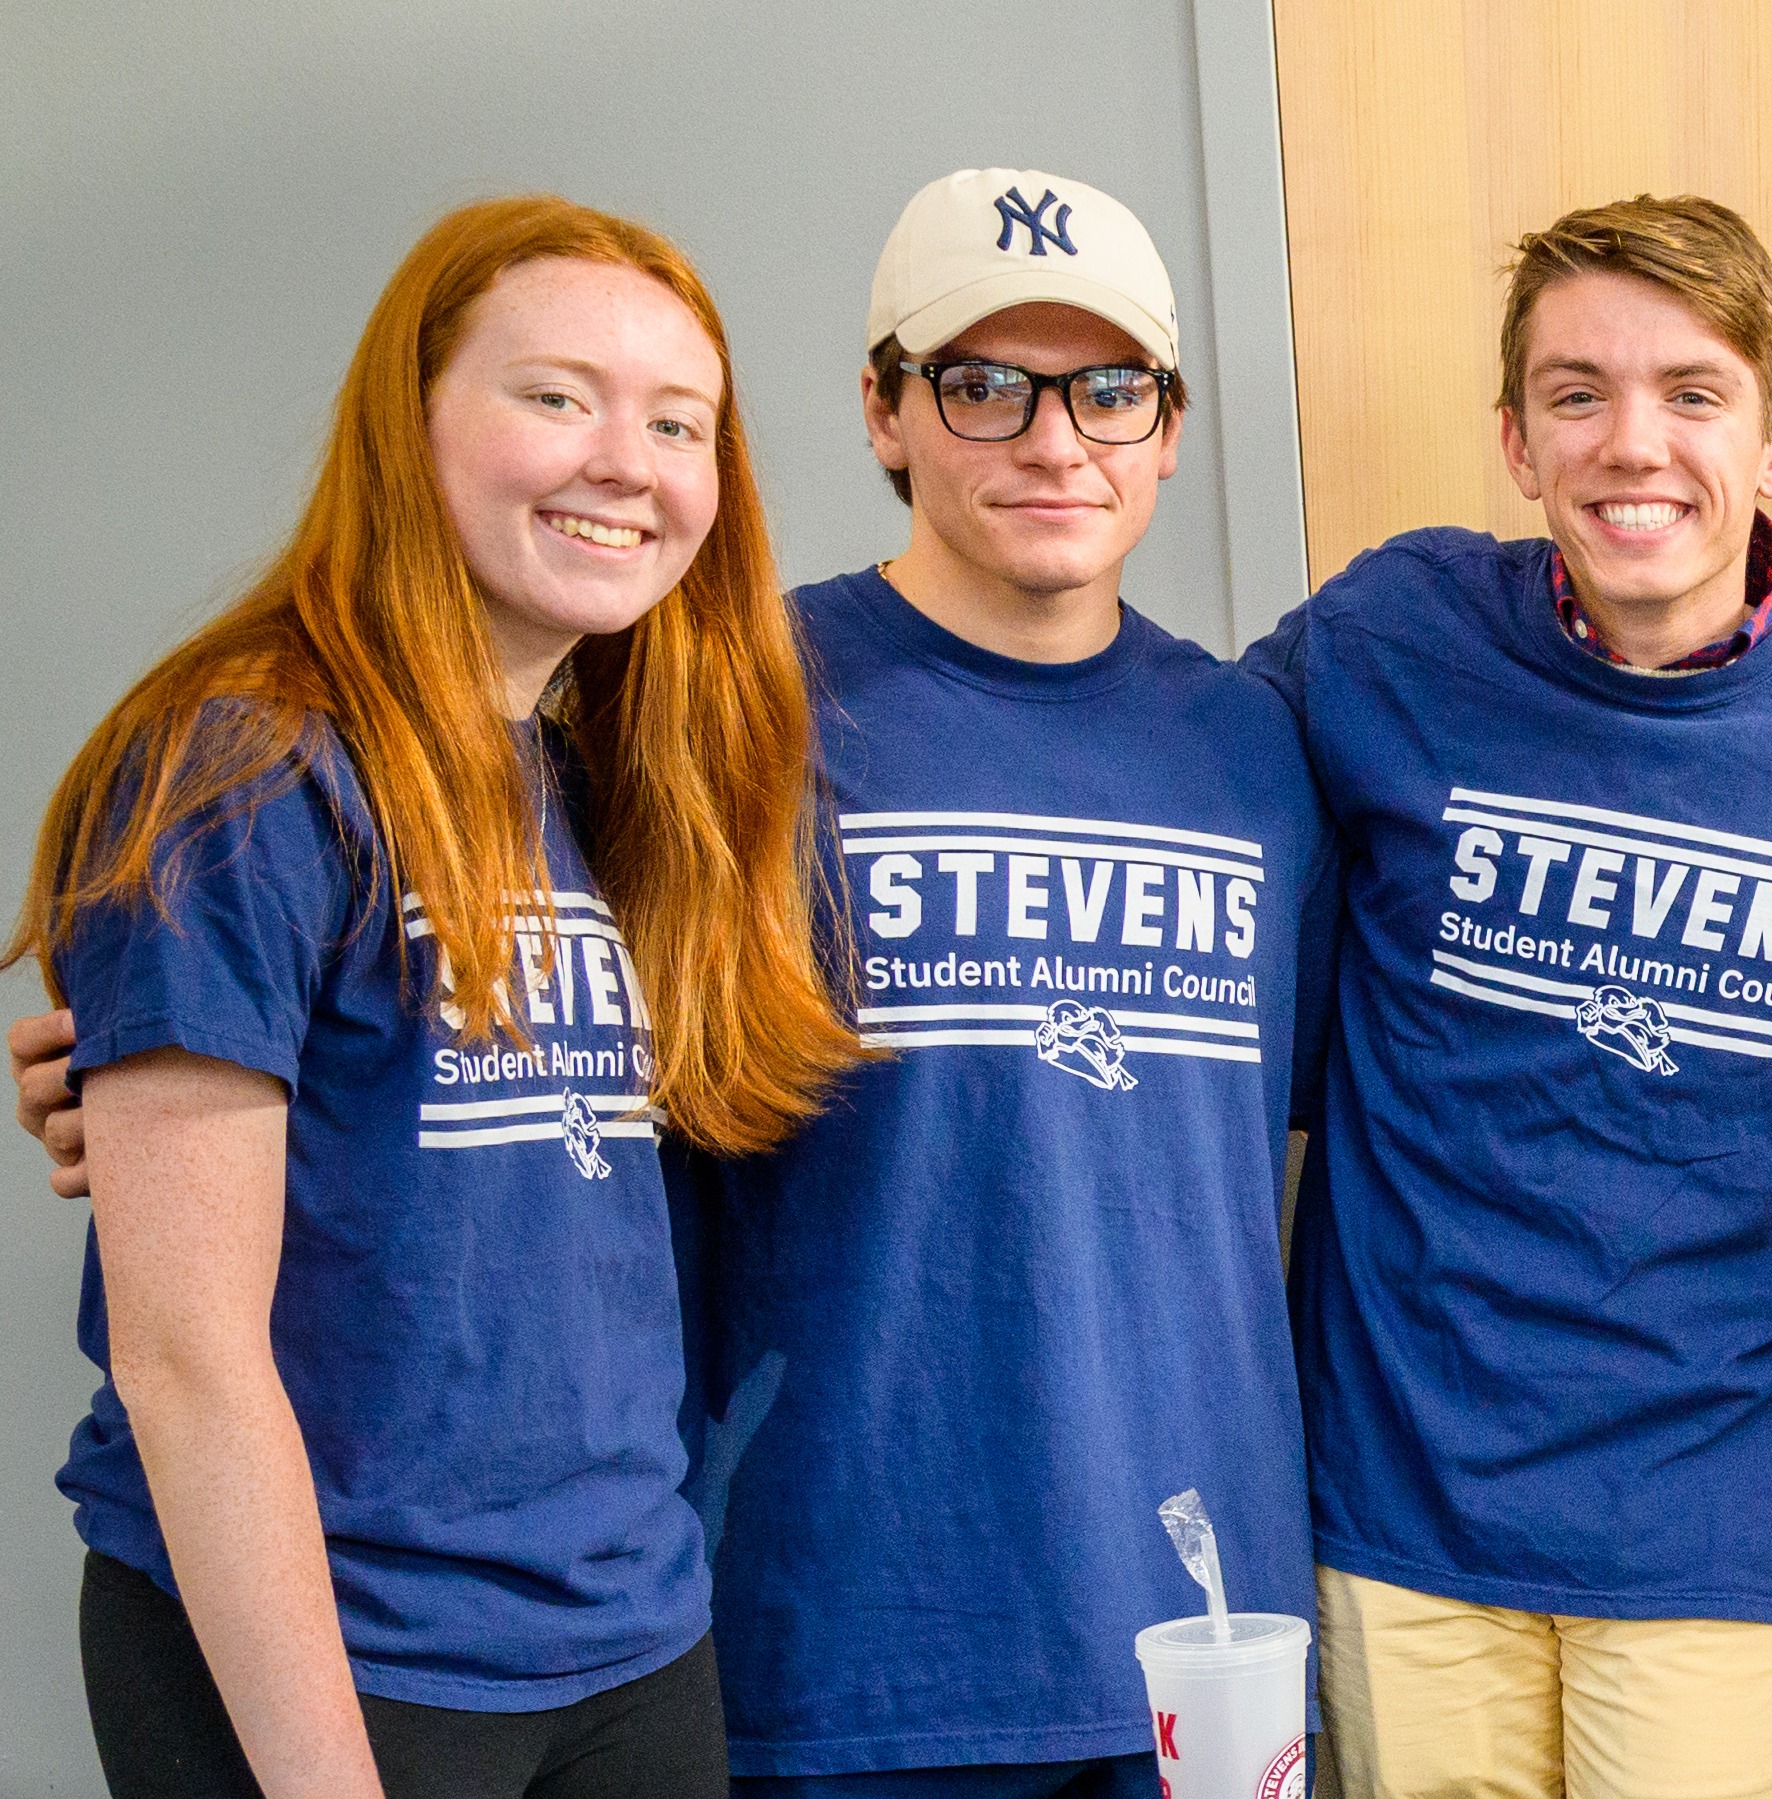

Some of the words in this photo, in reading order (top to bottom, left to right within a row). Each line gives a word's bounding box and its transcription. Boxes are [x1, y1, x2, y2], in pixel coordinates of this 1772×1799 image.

[869, 853, 1257, 959] STEVENS
[866, 953, 1021, 990] Student
[1031, 956, 1152, 995] Alumni
[1164, 965, 1256, 1007] Council
[1440, 911, 1574, 969] Student
[1580, 943, 1708, 994] Alumni
[434, 1044, 547, 1085] Student
